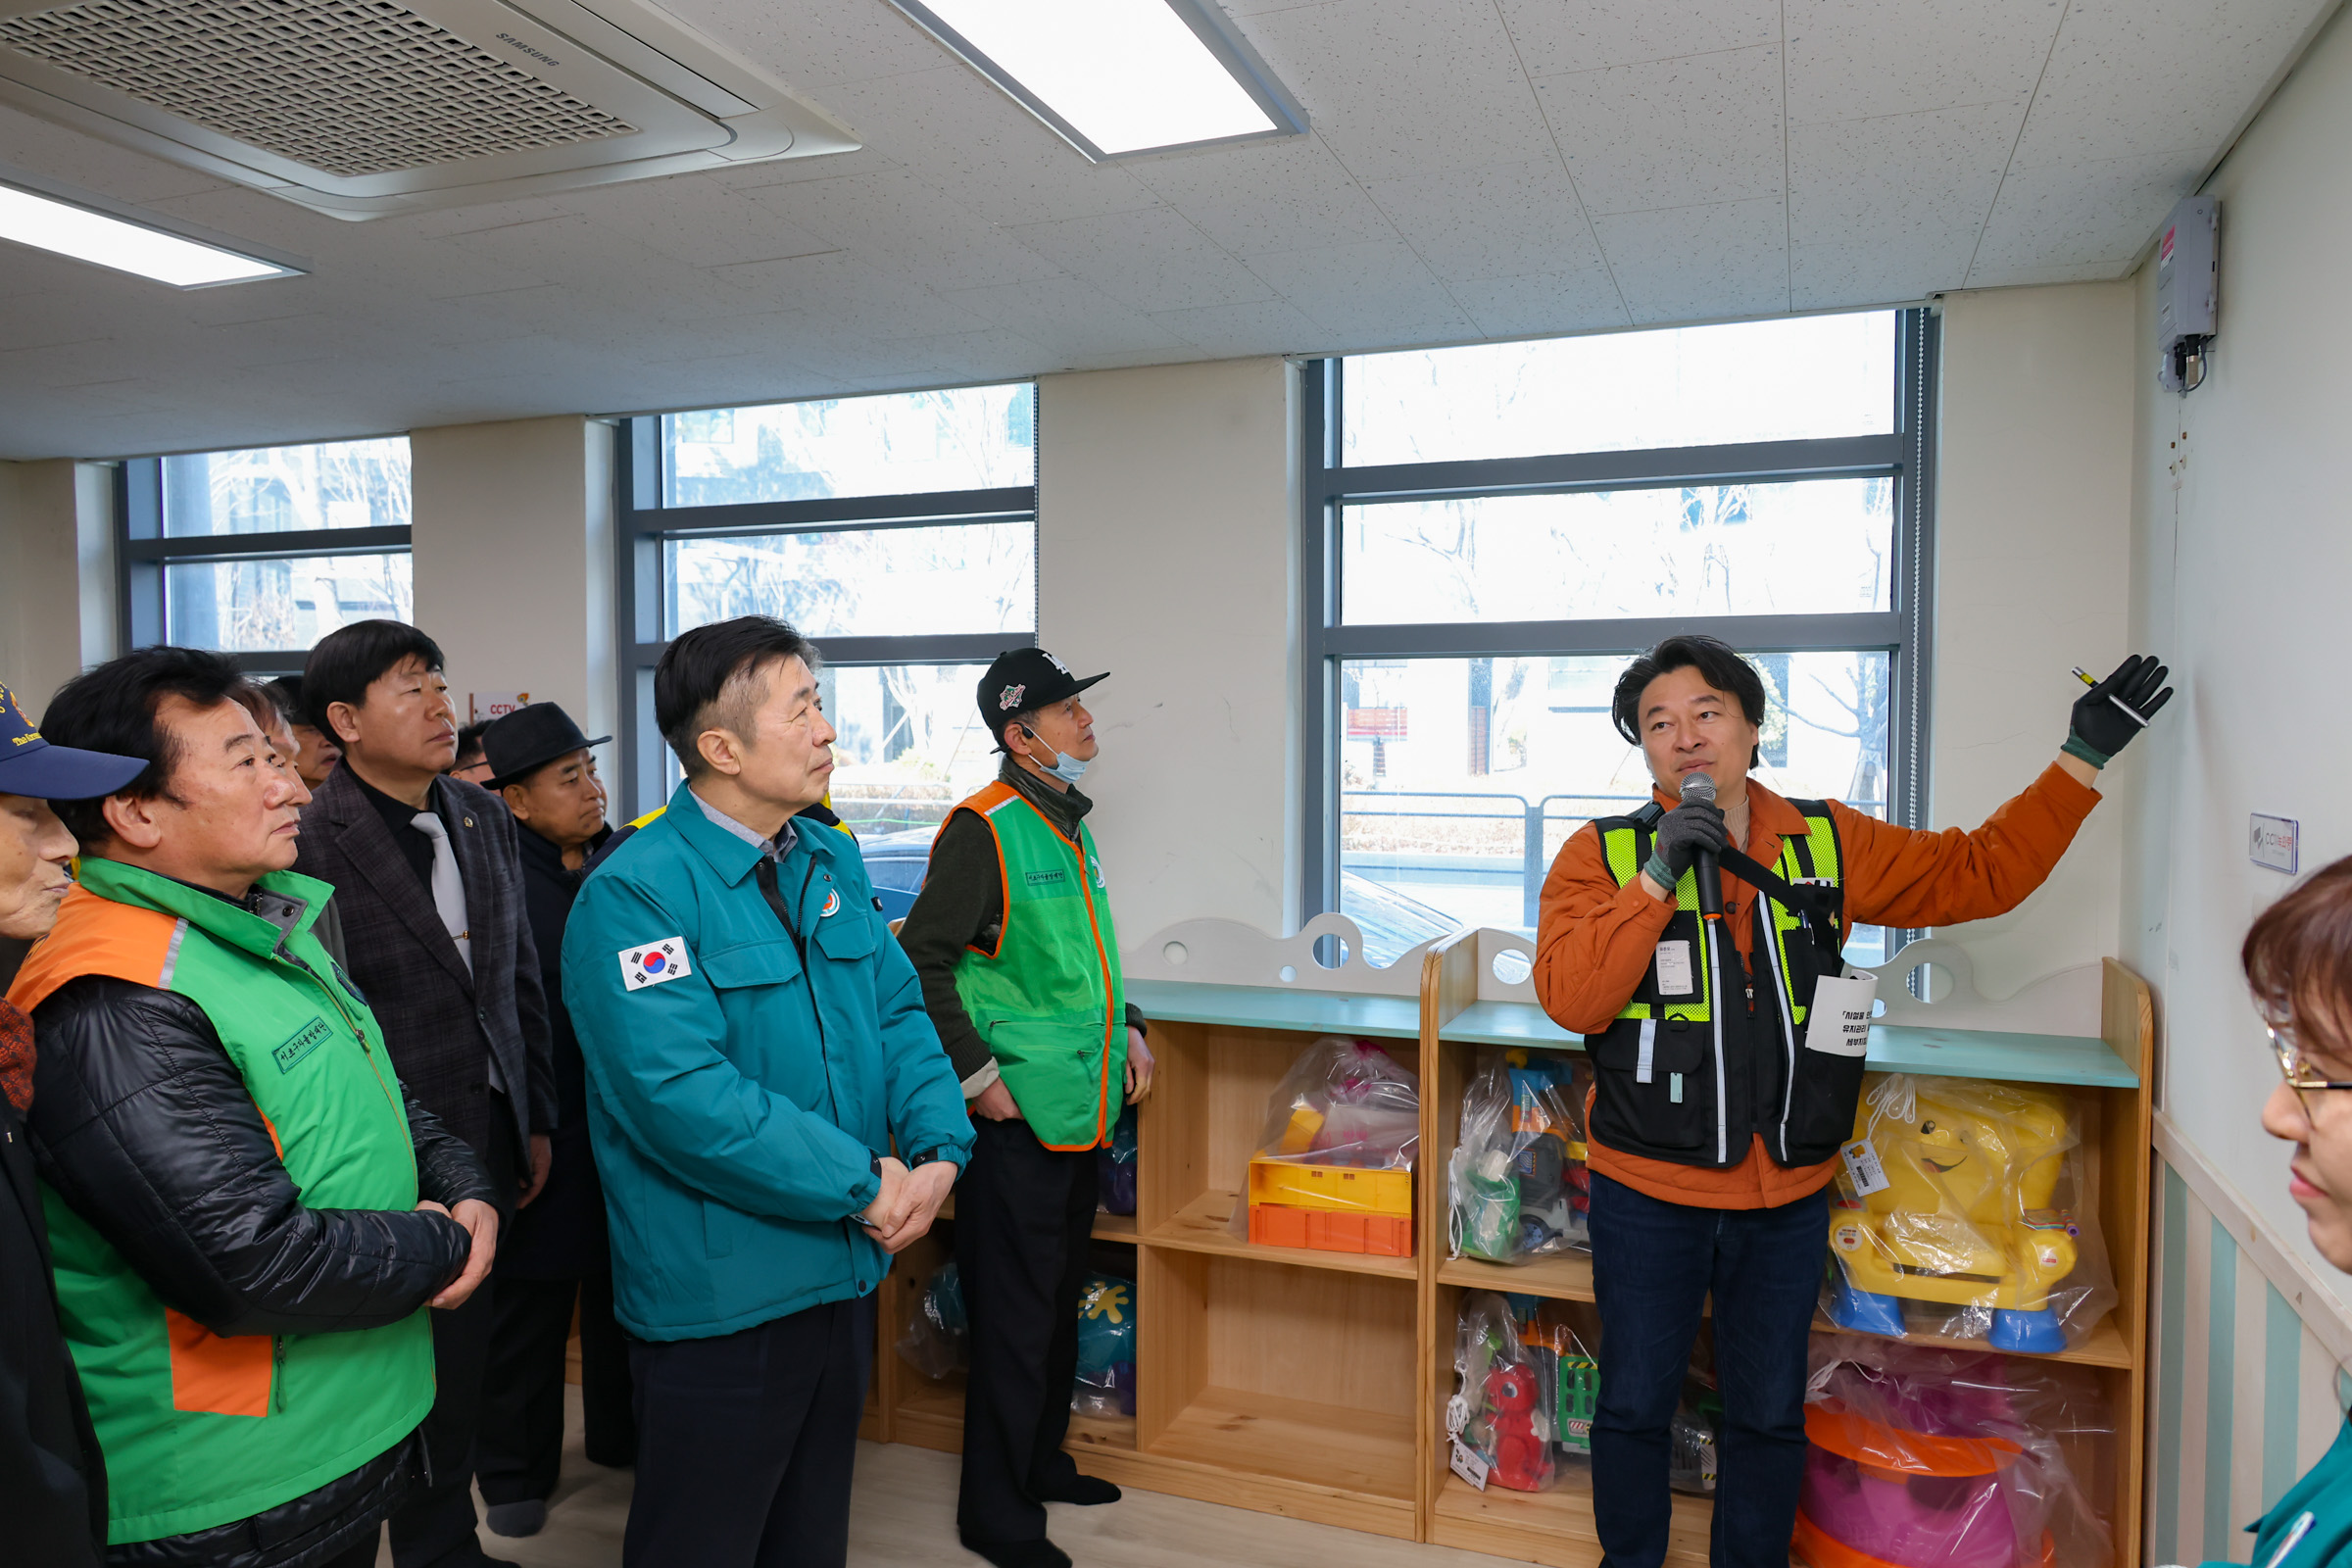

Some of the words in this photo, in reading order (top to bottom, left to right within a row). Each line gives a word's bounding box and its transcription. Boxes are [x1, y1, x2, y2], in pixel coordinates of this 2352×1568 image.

[495, 32, 560, 67] SAMSUNG
[490, 704, 515, 714] CCTV
[1842, 1024, 1867, 1034] 유지관리
